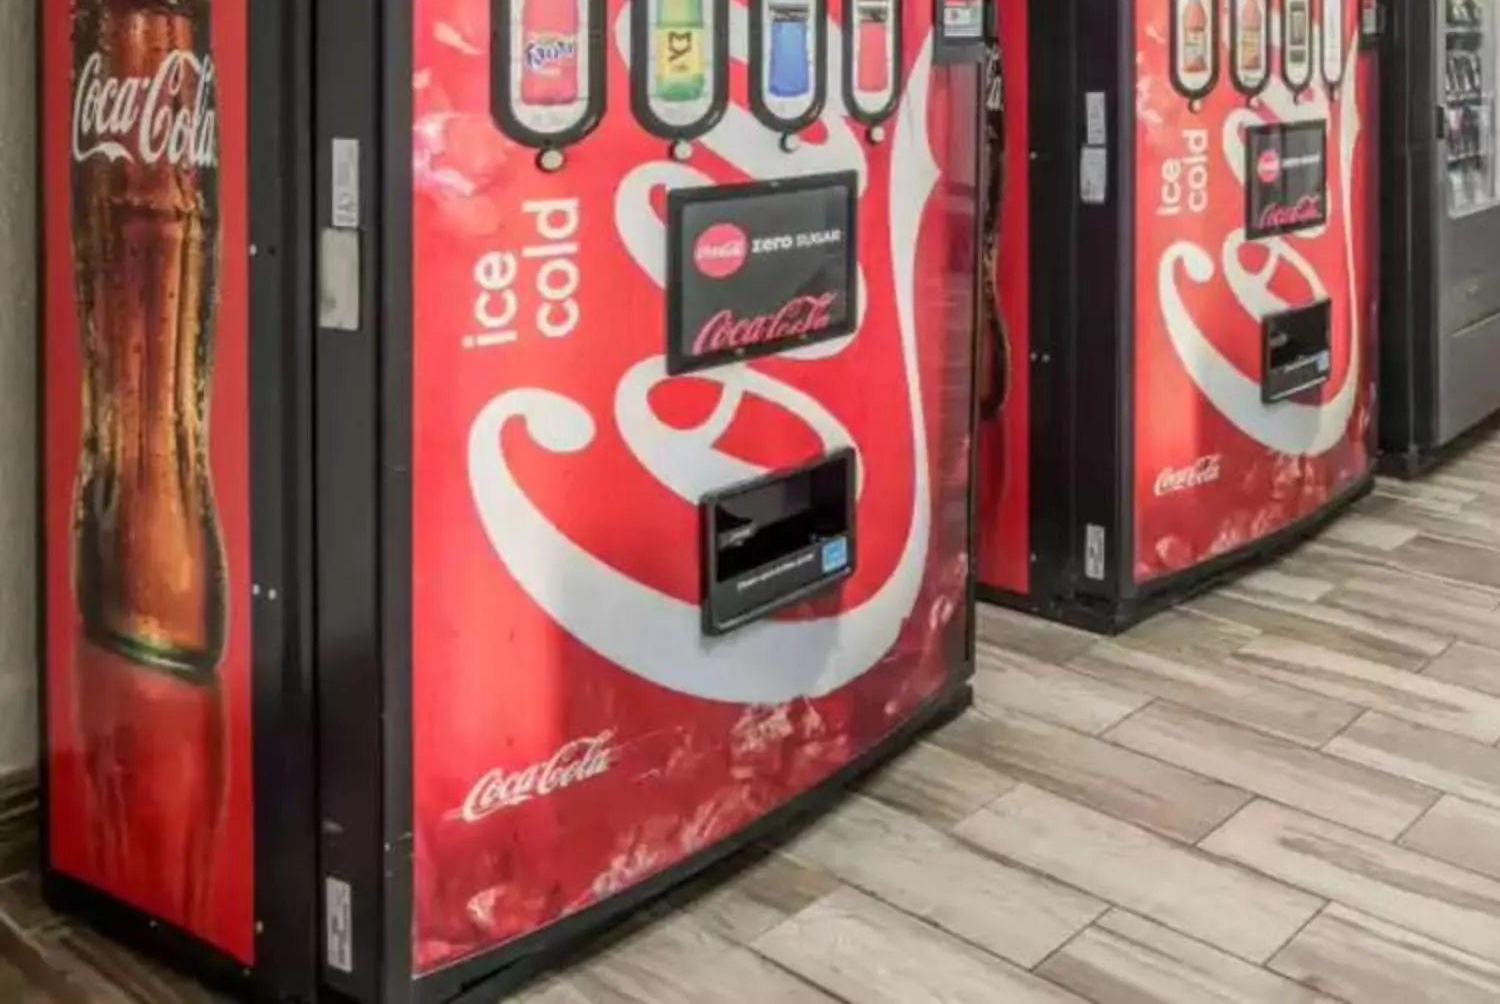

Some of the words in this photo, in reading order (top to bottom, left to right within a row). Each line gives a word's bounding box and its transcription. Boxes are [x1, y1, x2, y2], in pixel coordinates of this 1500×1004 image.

[1156, 157, 1182, 216] ice
[1182, 128, 1209, 213] cold
[522, 197, 580, 338] cold
[751, 234, 793, 254] zero
[796, 228, 842, 248] SUGAR
[462, 250, 518, 350] ice
